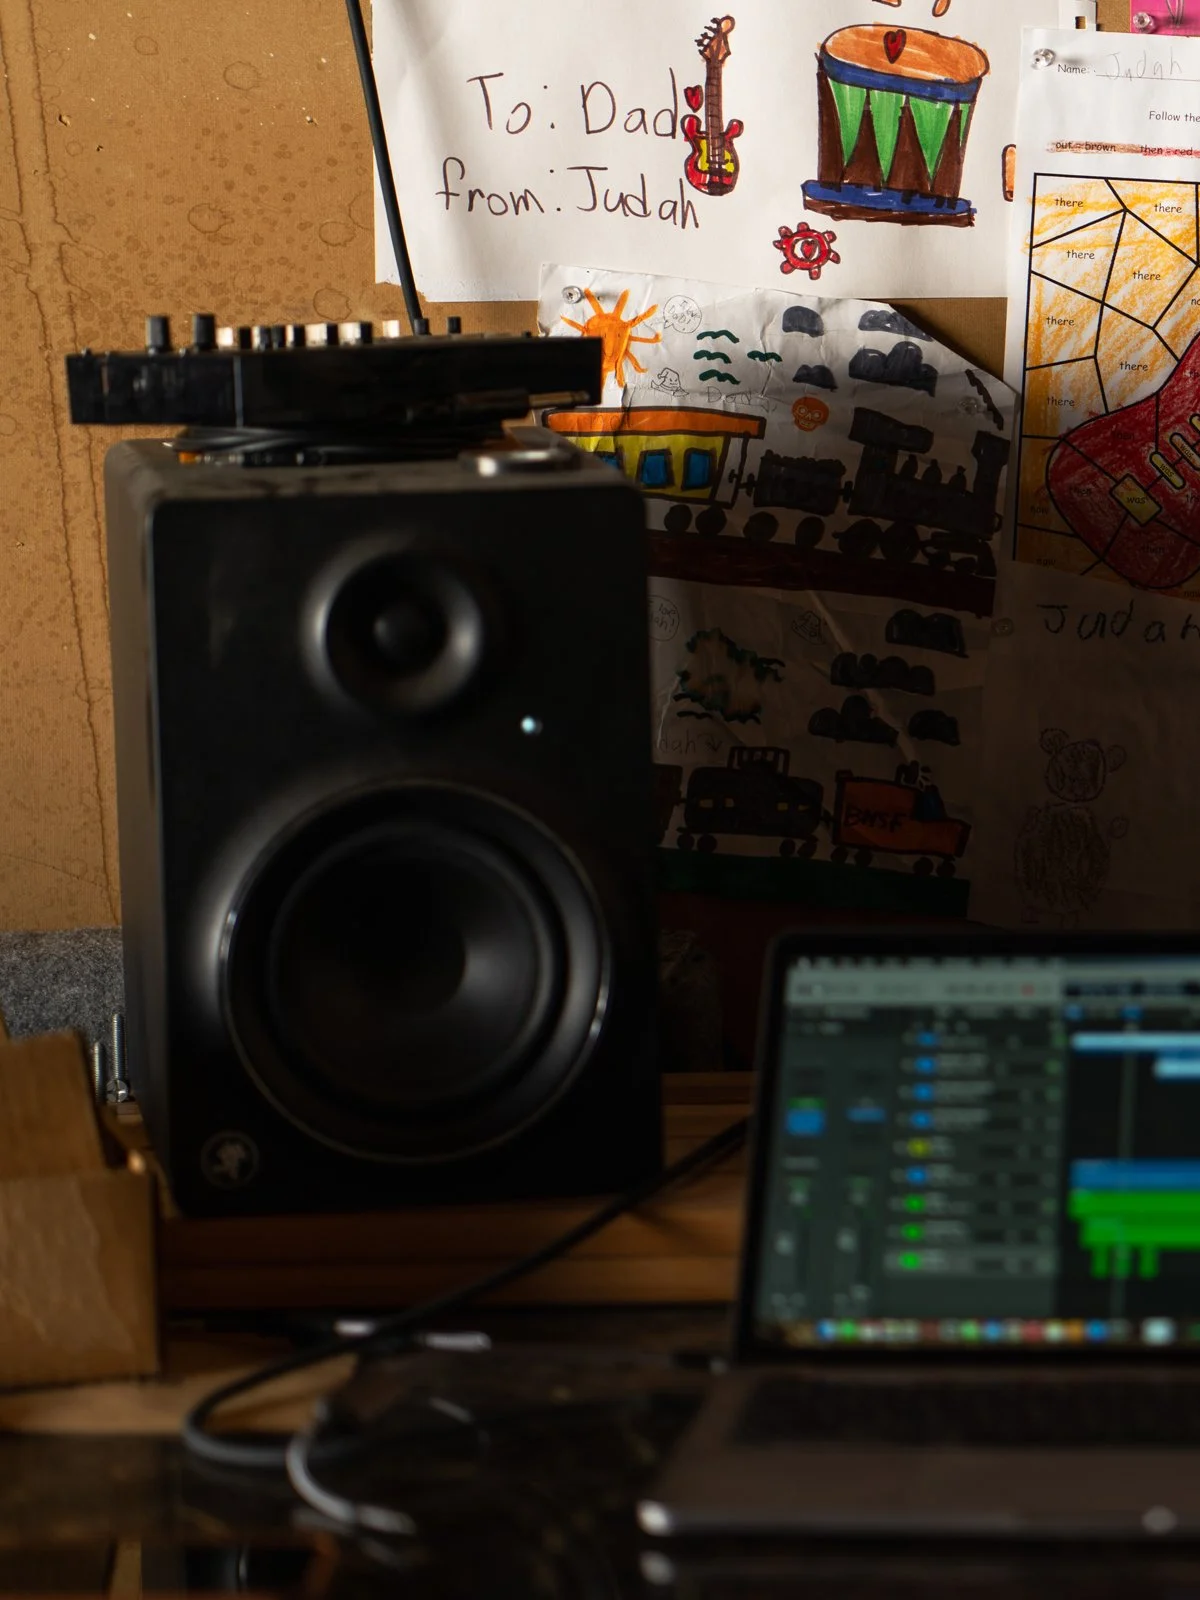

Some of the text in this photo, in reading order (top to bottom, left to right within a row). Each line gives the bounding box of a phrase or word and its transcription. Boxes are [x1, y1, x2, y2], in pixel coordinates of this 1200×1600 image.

[466, 67, 679, 140] To: Dad
[1149, 110, 1181, 121] Follow
[1184, 113, 1200, 123] the
[1055, 142, 1073, 150] out
[1084, 141, 1116, 152] brown
[1140, 145, 1163, 156] then
[1174, 147, 1193, 156] red
[435, 157, 699, 230] from: Judah
[1054, 198, 1084, 208] there
[1153, 203, 1183, 214] there
[1066, 250, 1096, 260] there
[1132, 271, 1162, 282] there
[1046, 316, 1075, 326] there
[1119, 361, 1148, 372] there
[1046, 396, 1076, 407] there
[1179, 444, 1194, 459] was
[1159, 462, 1175, 479] was
[1126, 496, 1146, 505] was
